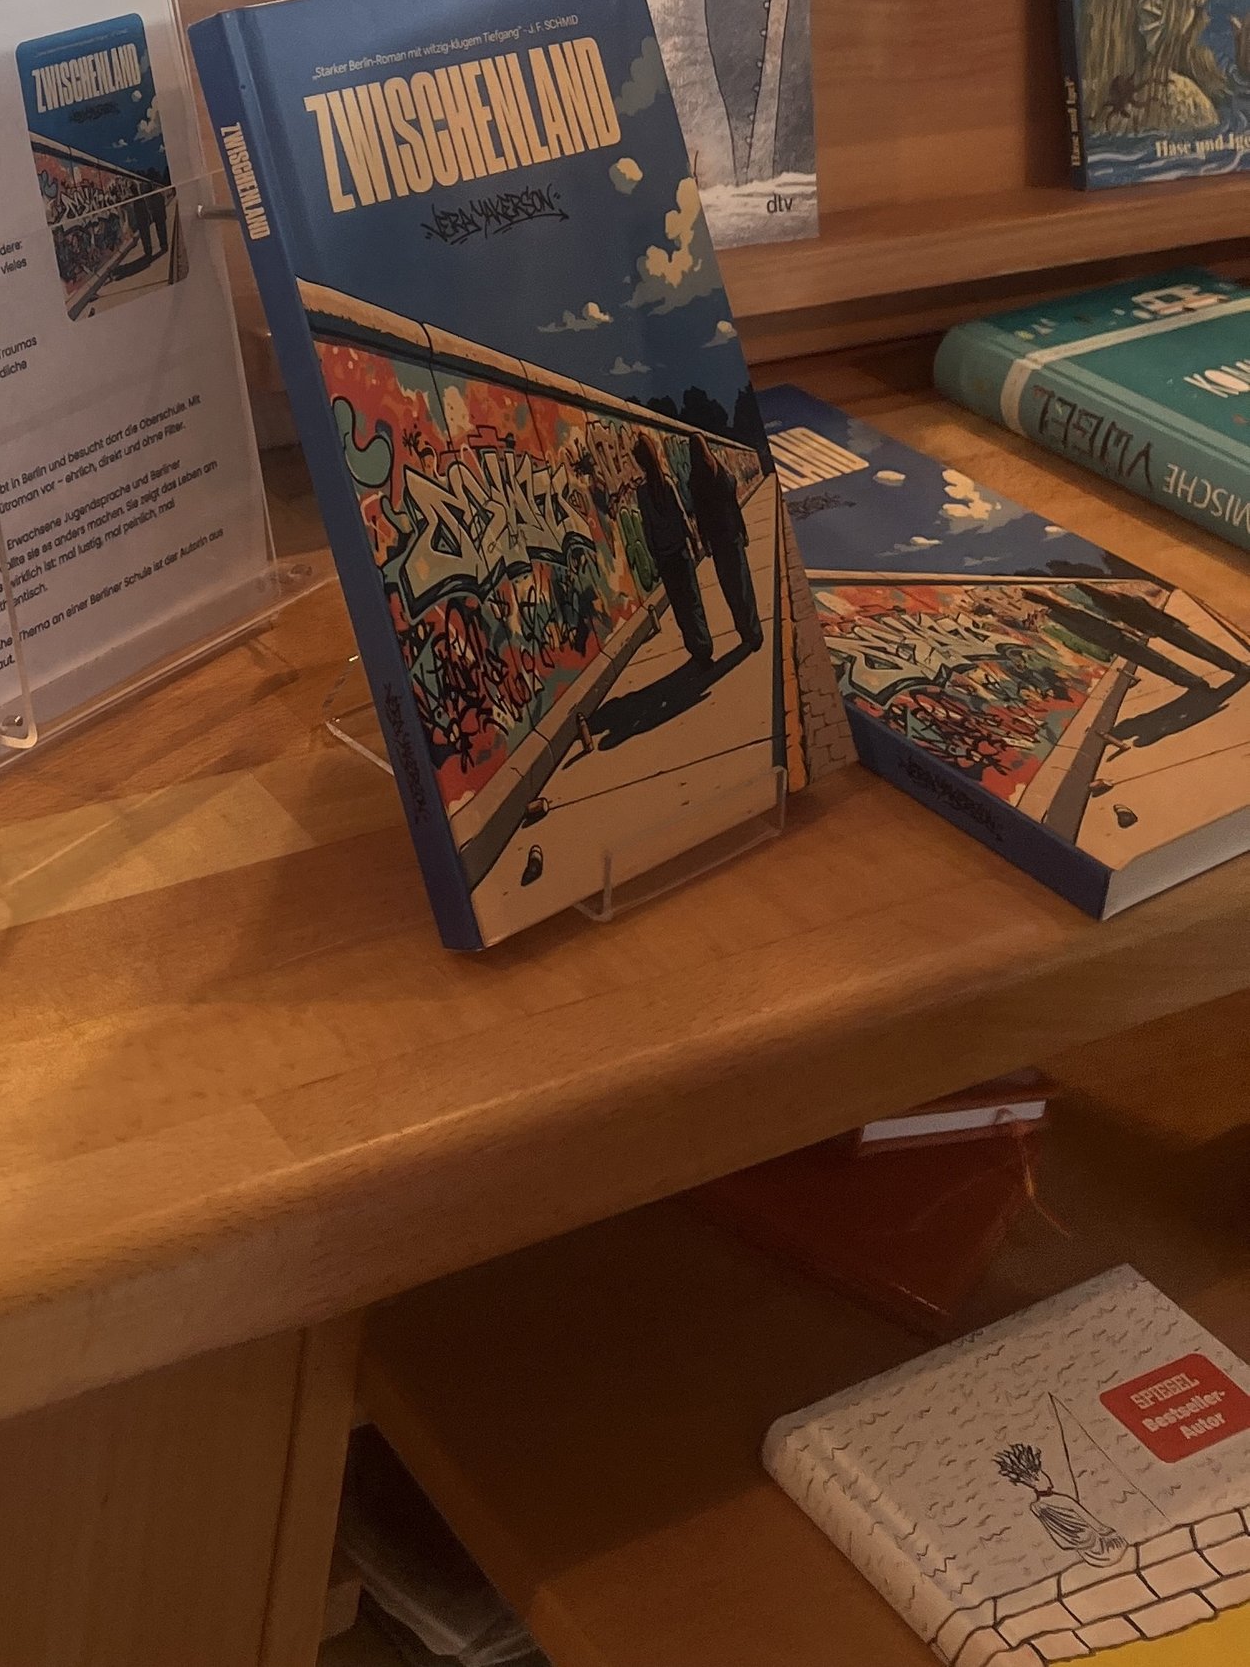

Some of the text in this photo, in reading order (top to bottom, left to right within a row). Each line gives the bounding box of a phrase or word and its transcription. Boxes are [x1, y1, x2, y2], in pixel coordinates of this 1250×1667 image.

[349, 50, 407, 72] Berlin-Roman
[408, 45, 422, 59] mit
[424, 35, 482, 57] witzig-klugem
[544, 14, 579, 31] SCHMID
[31, 43, 141, 114] ZWISCHENLAND
[303, 36, 622, 214] ZWISCHENLAND
[1155, 138, 1191, 158] Hase
[220, 121, 270, 240] ZWISCHENLAND
[766, 192, 792, 215] dtv
[1130, 1372, 1200, 1410] SPIEGEL
[1142, 1390, 1226, 1432] Bestseller-
[1179, 1412, 1227, 1440] Autor
